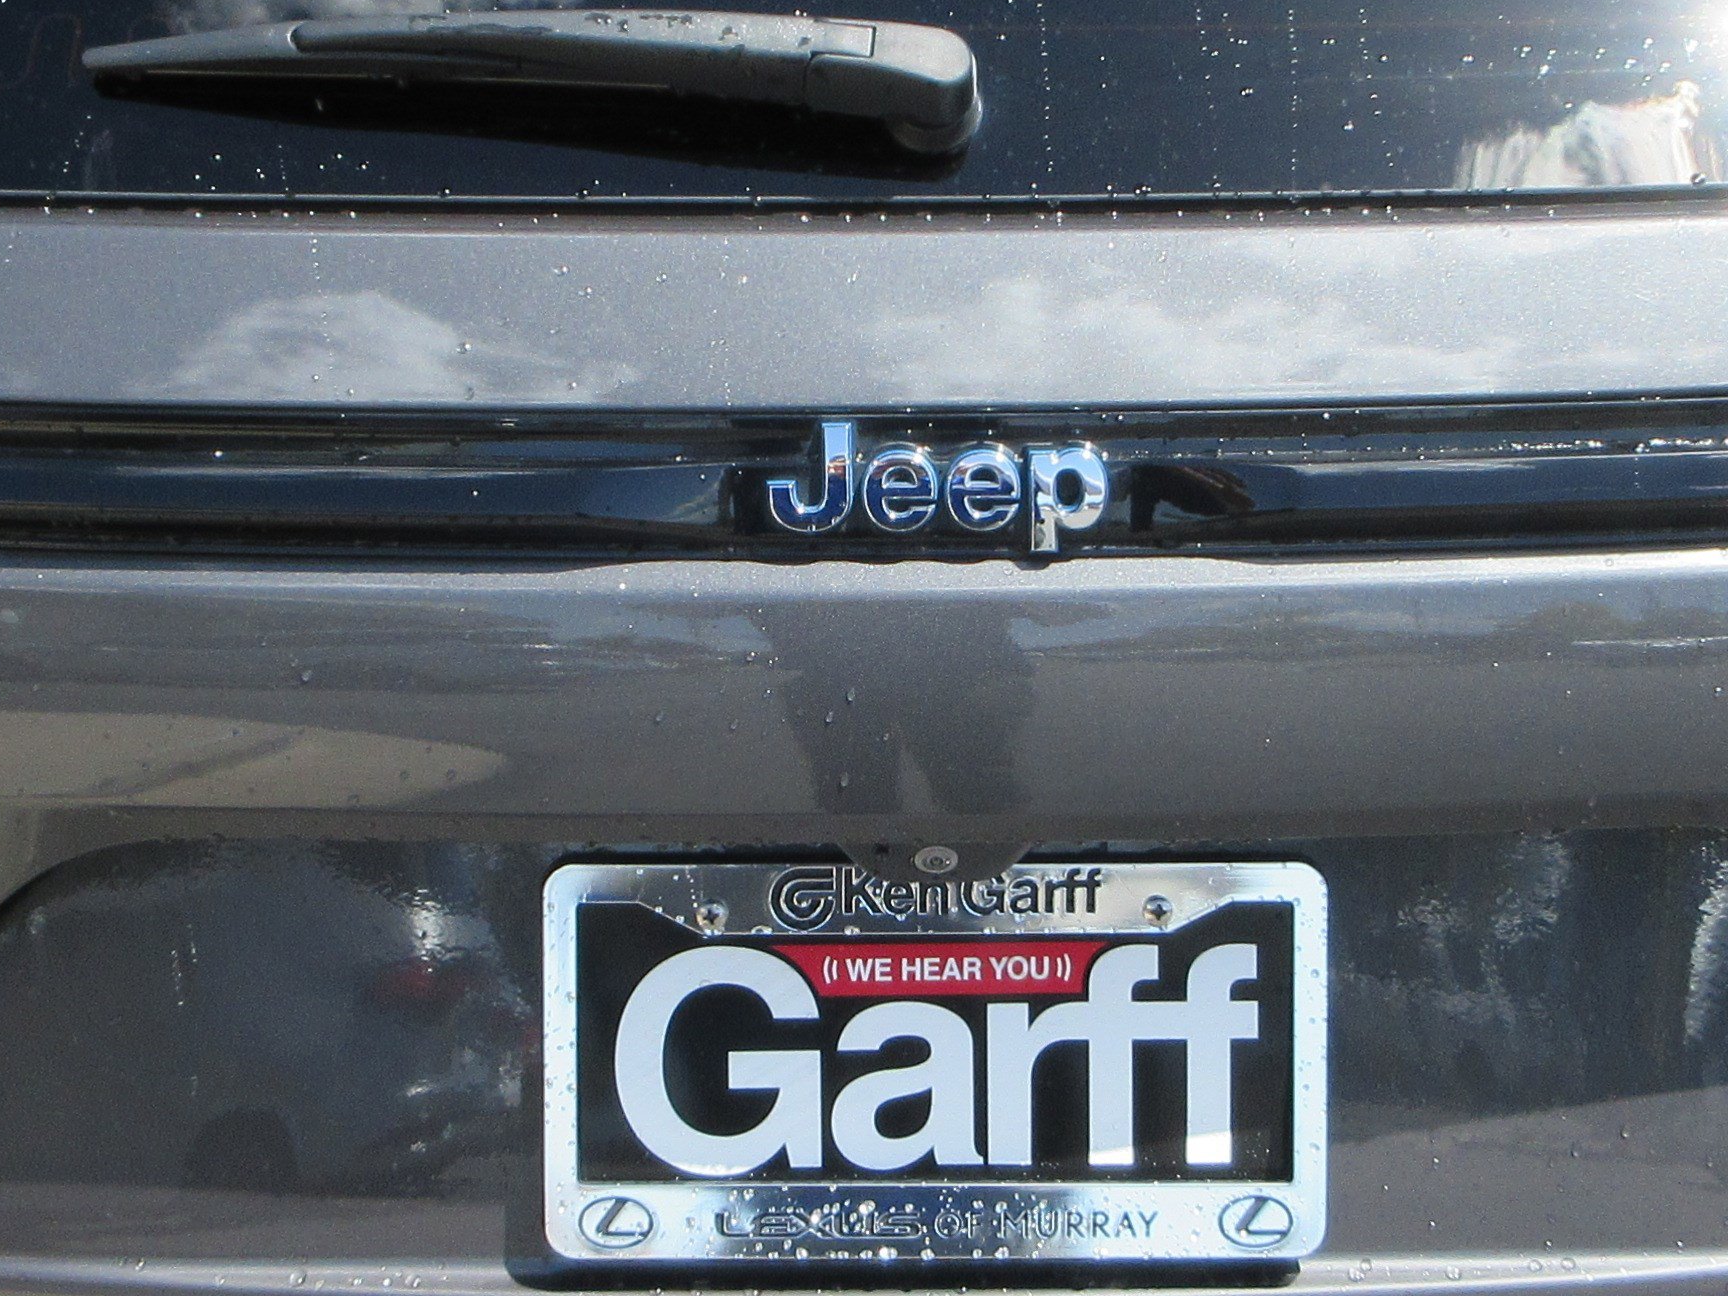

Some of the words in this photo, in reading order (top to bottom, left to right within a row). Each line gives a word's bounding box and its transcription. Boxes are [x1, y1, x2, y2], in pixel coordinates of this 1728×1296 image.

[766, 422, 1109, 554] Jeep
[840, 865, 950, 916] Ken
[960, 865, 1103, 916] Garff
[845, 957, 893, 982] WE
[900, 956, 983, 982] HEAR
[988, 955, 1050, 981] YOU
[613, 942, 1260, 1177] Garff
[714, 1210, 923, 1239] LEXUS
[934, 1209, 985, 1239] OF
[998, 1208, 1159, 1239] MURRAY
